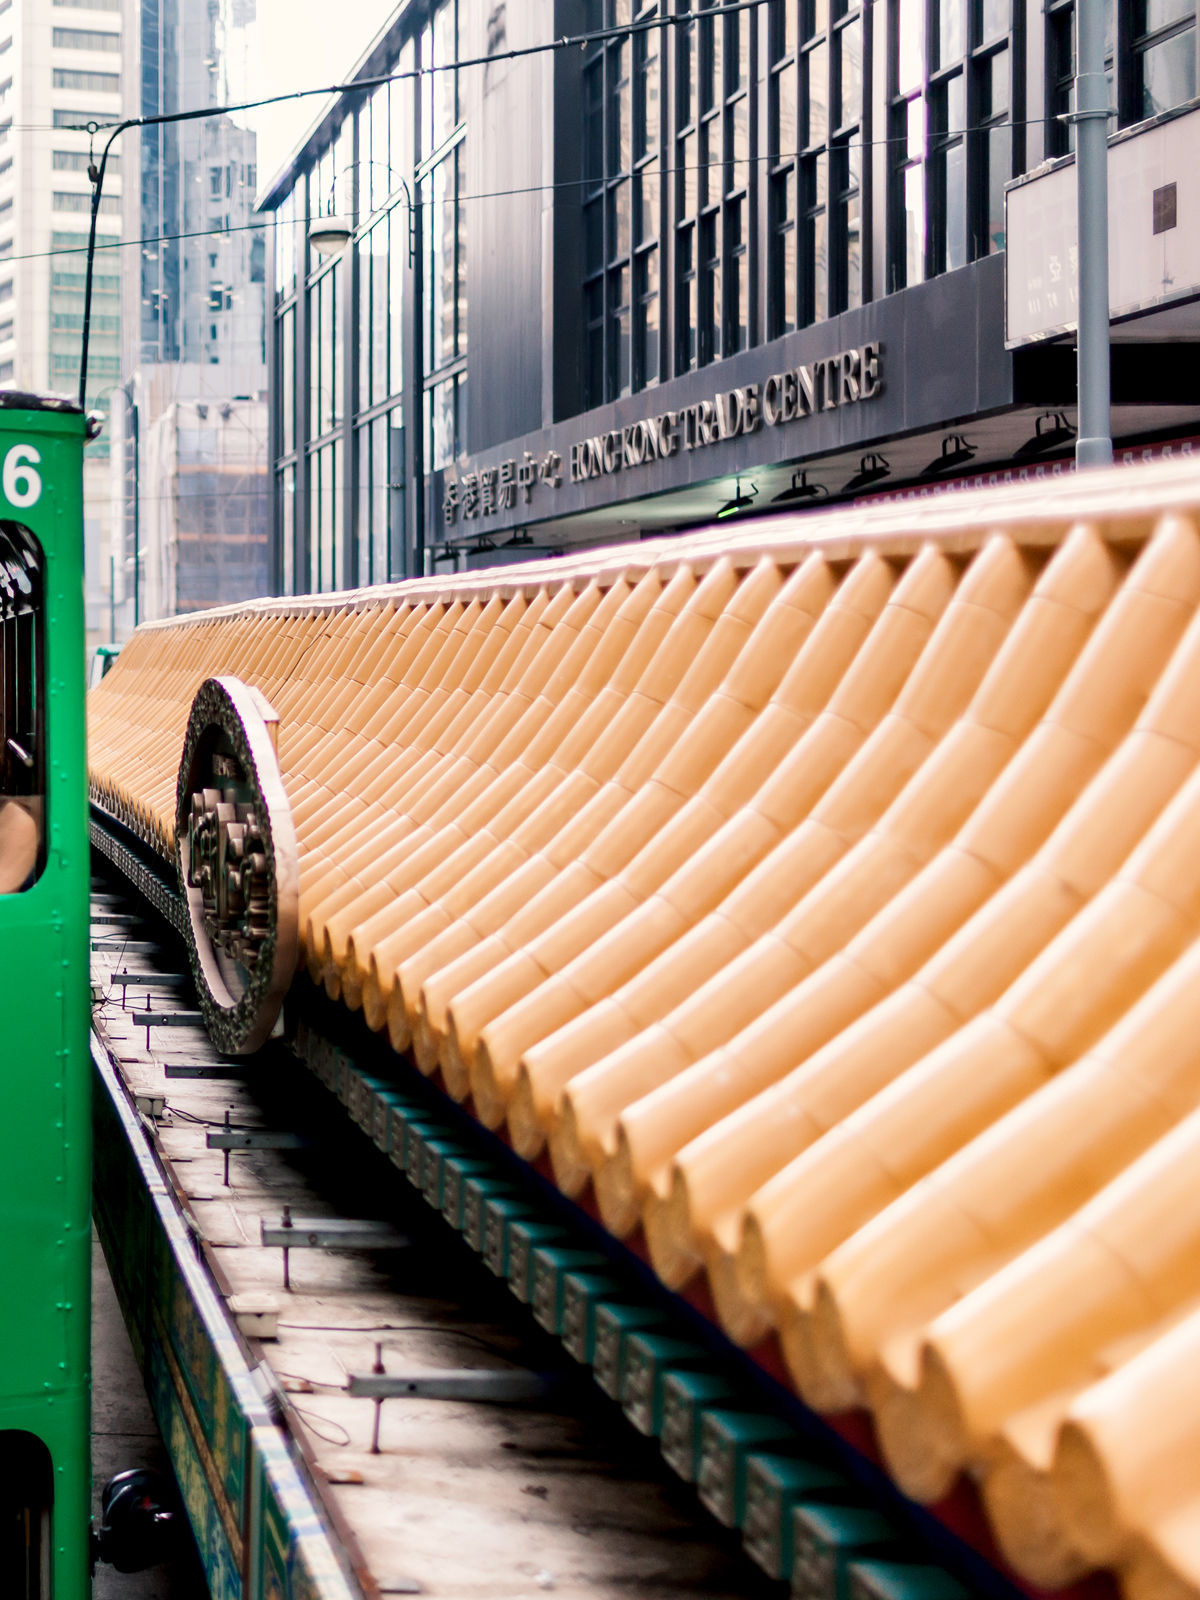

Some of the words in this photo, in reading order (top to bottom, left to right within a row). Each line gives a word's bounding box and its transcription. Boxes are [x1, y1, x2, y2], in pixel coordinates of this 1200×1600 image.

[568, 430, 622, 483] HONG
[621, 411, 679, 469] KONG
[679, 384, 761, 451] TRADE
[762, 341, 883, 427] CENTRE
